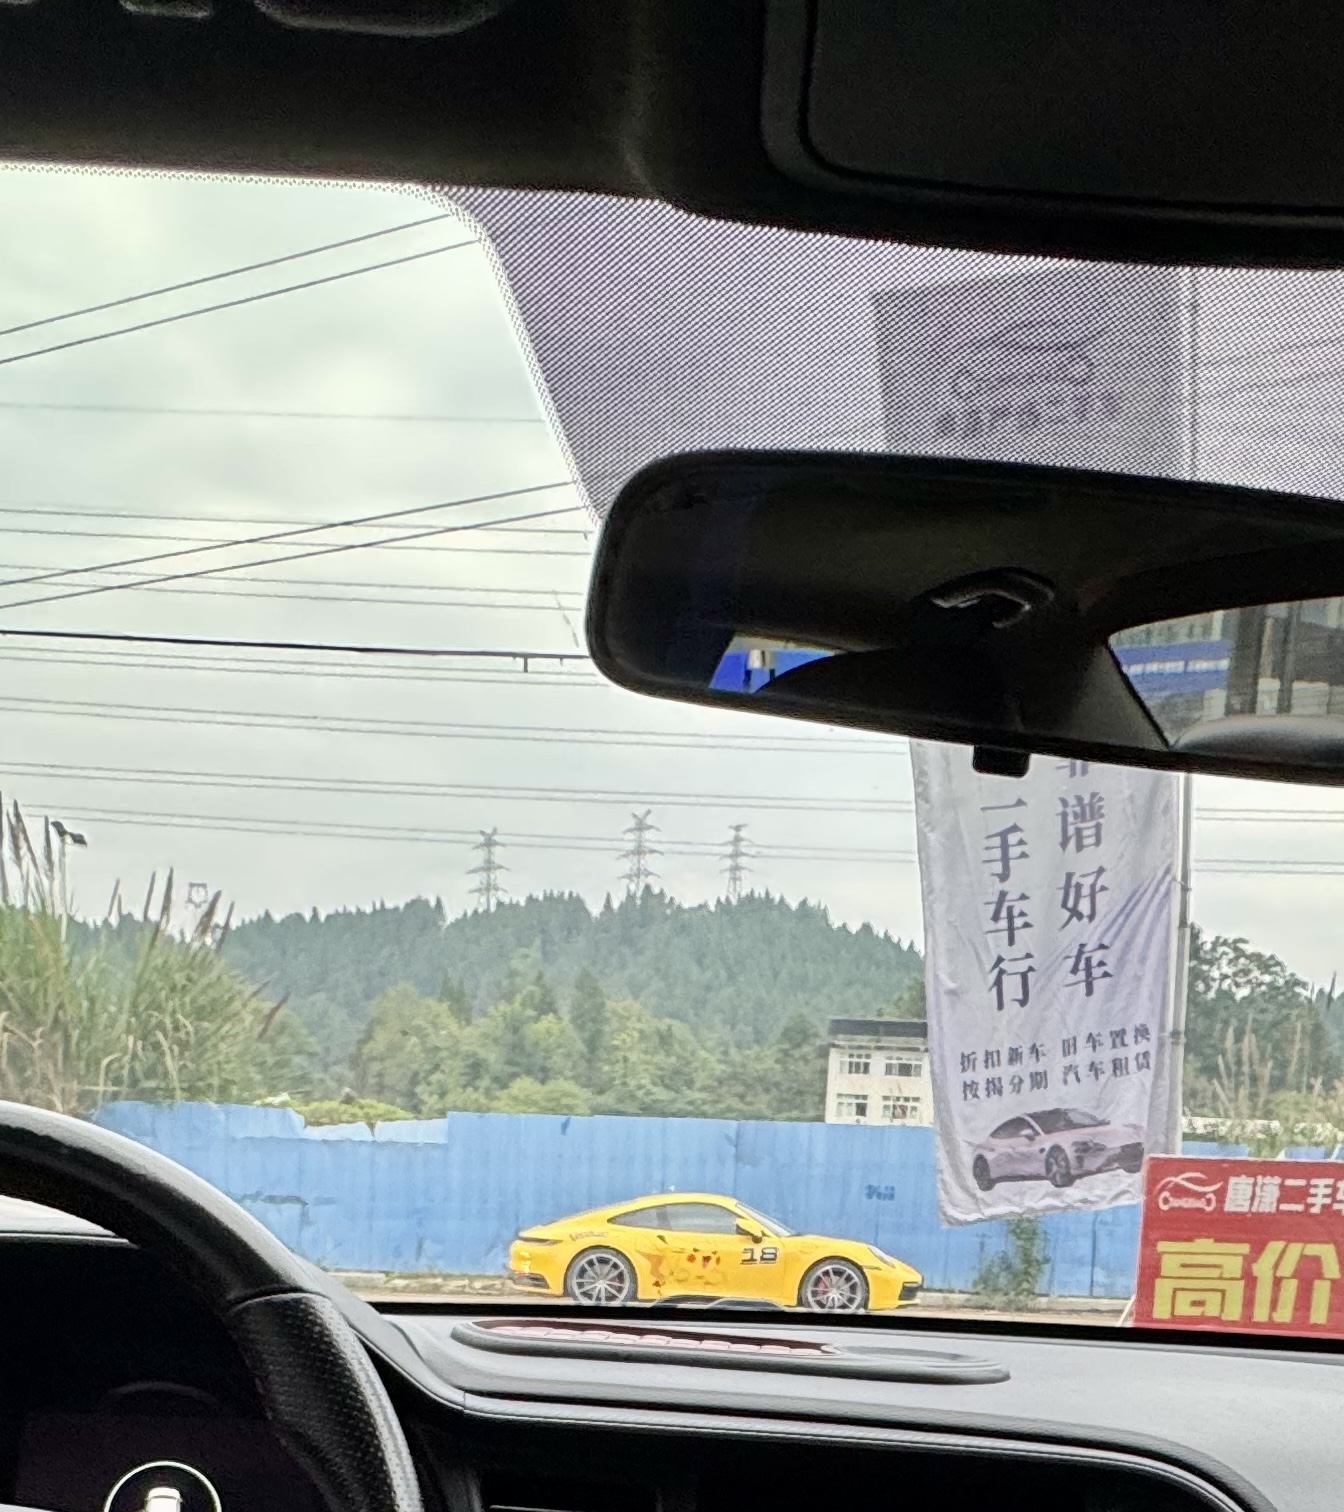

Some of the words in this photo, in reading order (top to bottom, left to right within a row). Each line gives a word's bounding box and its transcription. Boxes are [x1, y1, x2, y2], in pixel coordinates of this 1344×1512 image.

[1055, 760, 1114, 997] 谱好车
[960, 1042, 1047, 1073] 折扣新车
[1061, 1023, 1151, 1057] 旧车置换
[962, 1070, 1049, 1101] 按揭分期
[1063, 1050, 1152, 1086] 汽车租赁
[740, 1246, 778, 1265] 18
[1153, 1238, 1342, 1326] 高价
